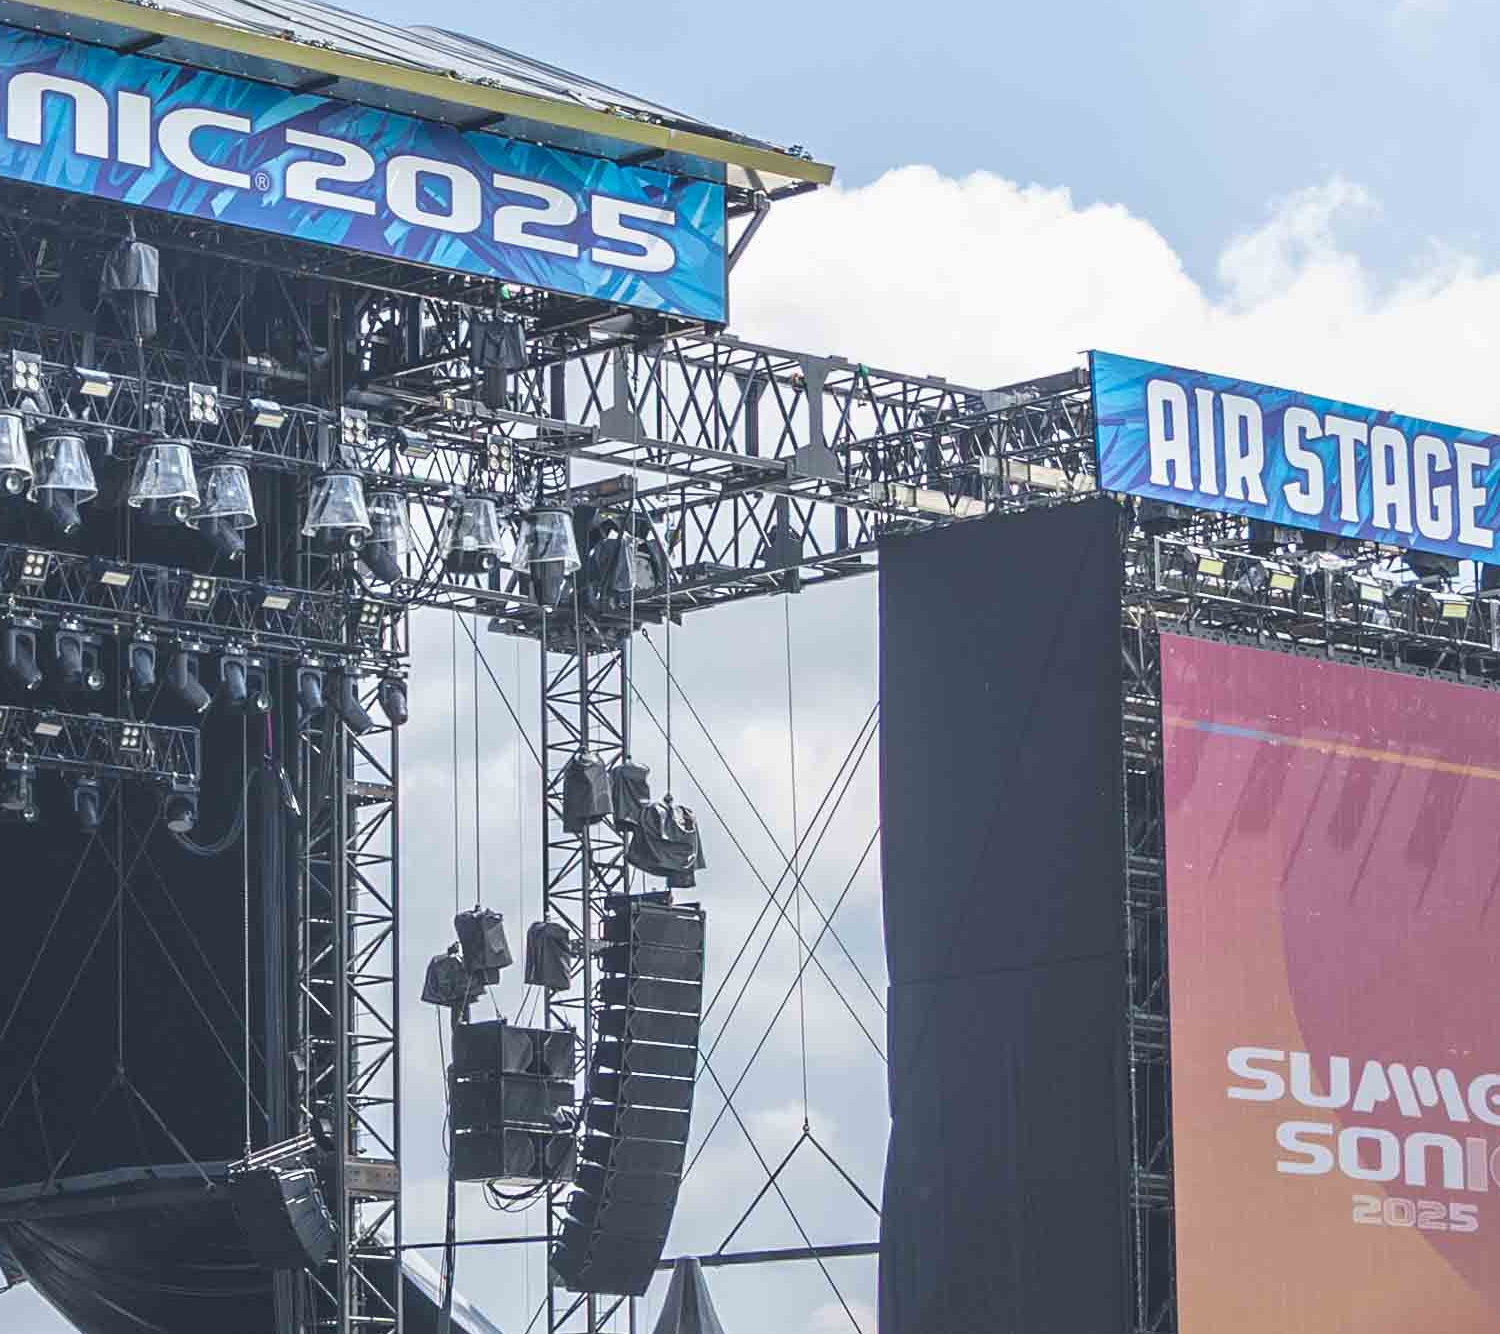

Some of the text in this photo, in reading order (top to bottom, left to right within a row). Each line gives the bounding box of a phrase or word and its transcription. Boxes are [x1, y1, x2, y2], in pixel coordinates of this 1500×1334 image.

[280, 128, 677, 275] 2025
[1146, 378, 1493, 549] AIR STAGE
[1352, 1194, 1478, 1233] 2025
